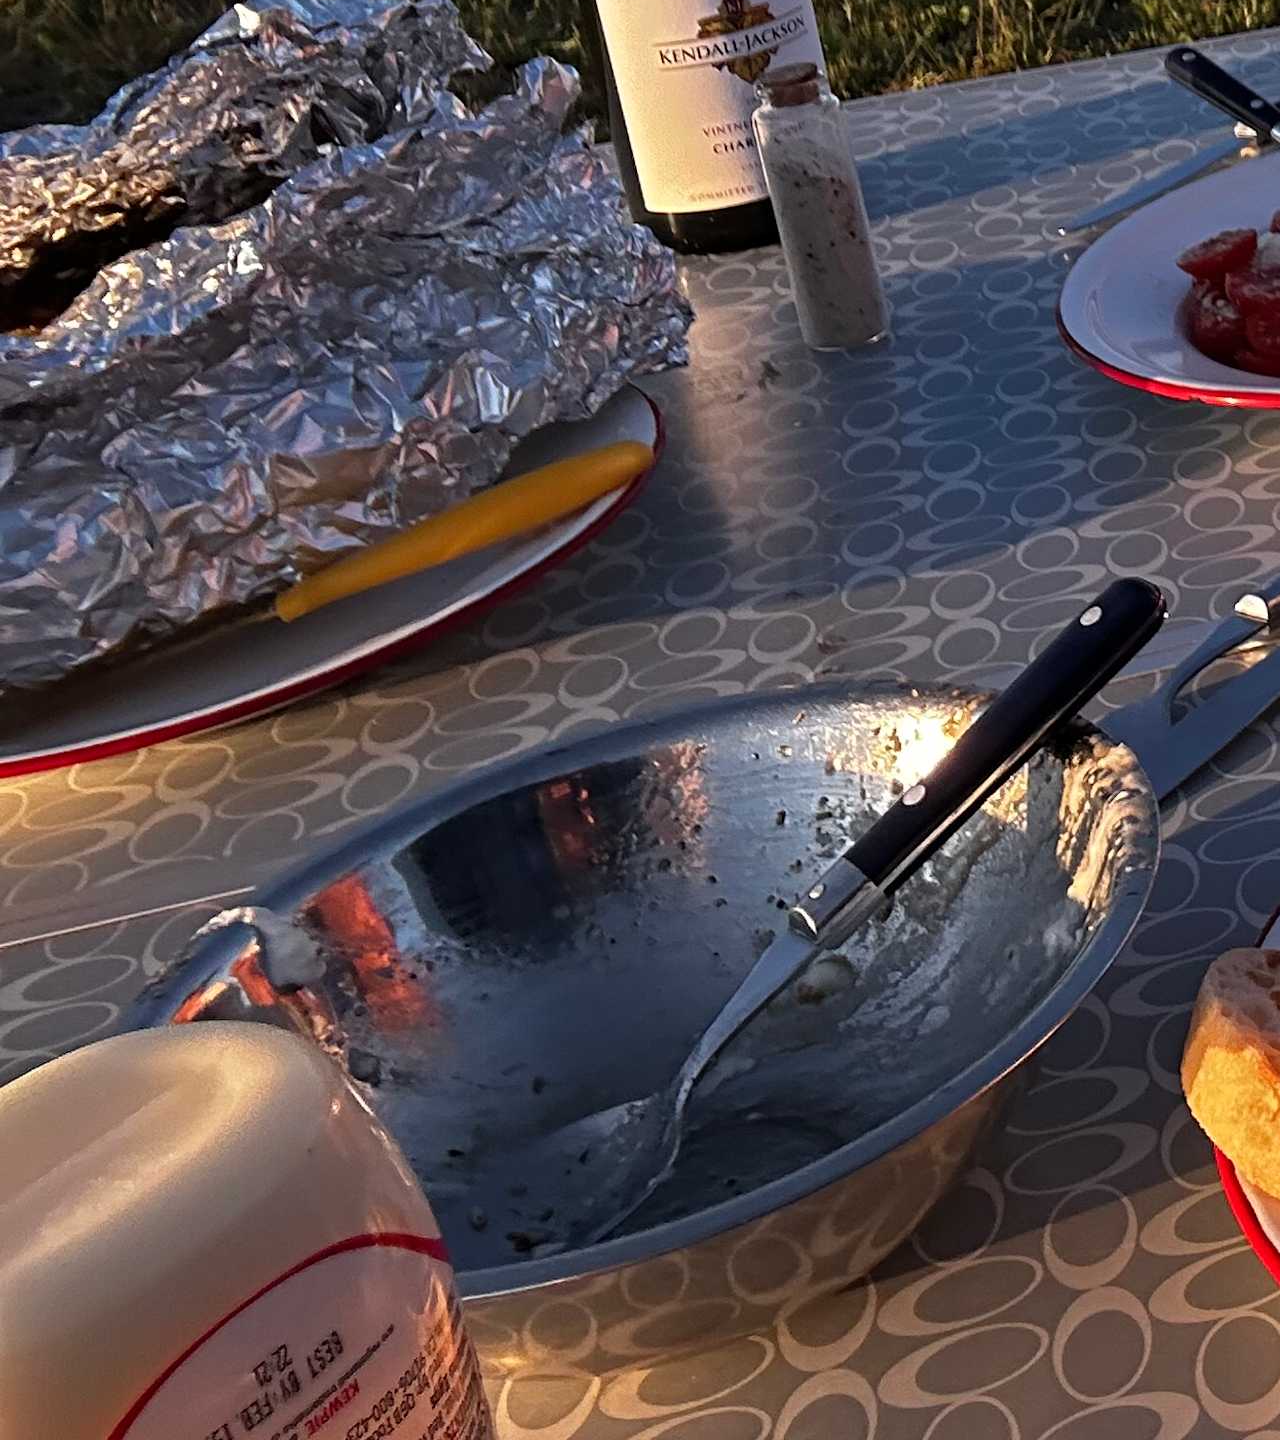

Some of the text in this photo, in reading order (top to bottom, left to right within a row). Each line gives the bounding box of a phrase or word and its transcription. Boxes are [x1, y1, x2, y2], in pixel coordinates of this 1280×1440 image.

[659, 16, 806, 65] KENDALL-JACKSON
[703, 116, 757, 138] VINTNE
[307, 1331, 343, 1379] BEST
[280, 1369, 301, 1401] BY
[304, 1377, 359, 1438] KEWPIE
